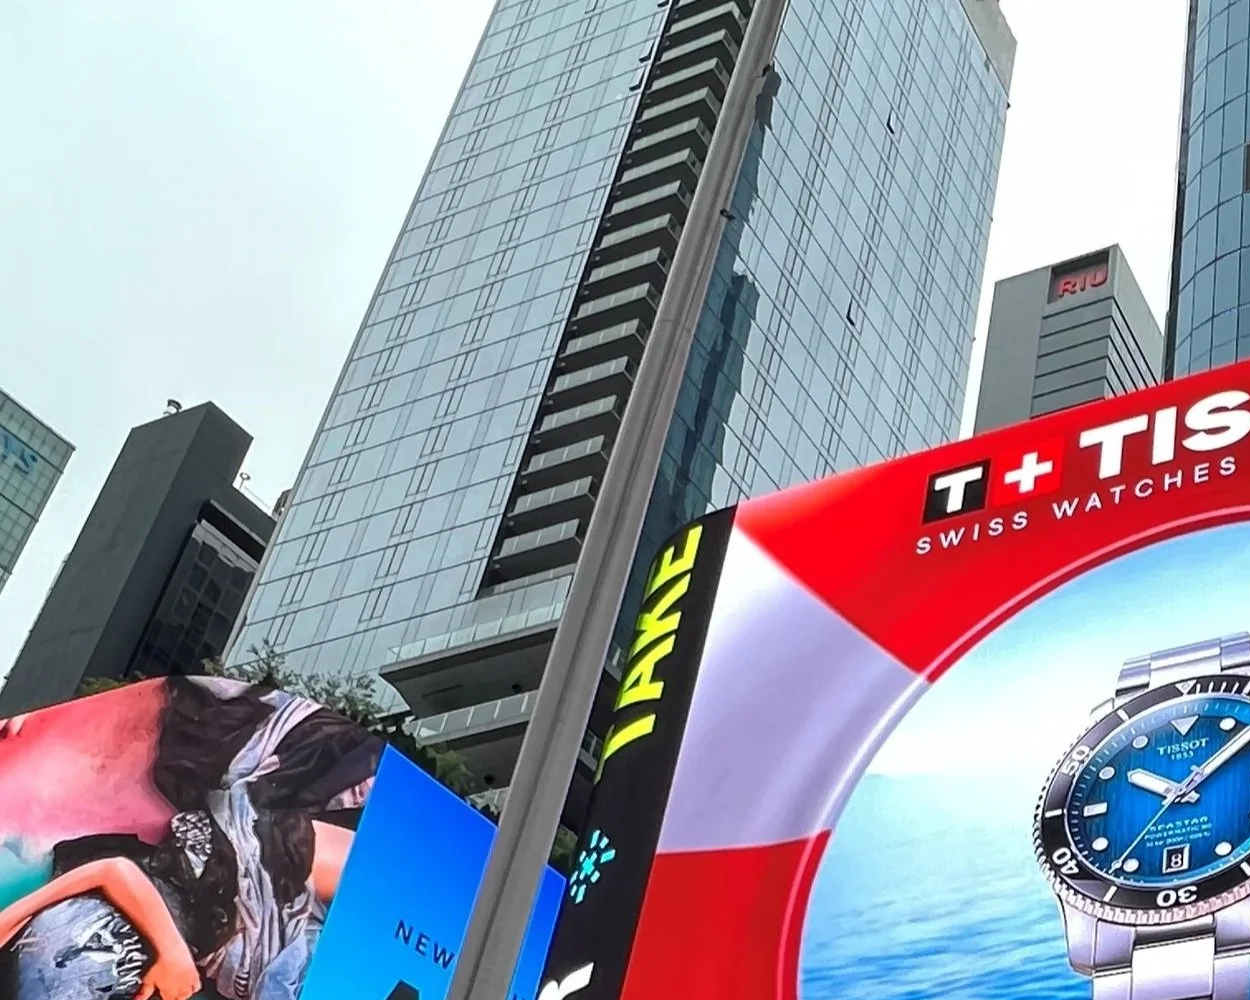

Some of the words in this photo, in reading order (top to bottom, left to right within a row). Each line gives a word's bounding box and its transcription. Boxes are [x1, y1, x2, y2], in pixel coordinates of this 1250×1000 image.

[1059, 267, 1109, 298] RIU
[915, 511, 1029, 555] SWISS
[1052, 456, 1237, 521] WATCHES
[1062, 744, 1092, 777] 50
[1156, 737, 1210, 757] TISSOT
[1051, 847, 1080, 876] 40
[1156, 885, 1199, 908] 30
[395, 918, 455, 970] NEW
